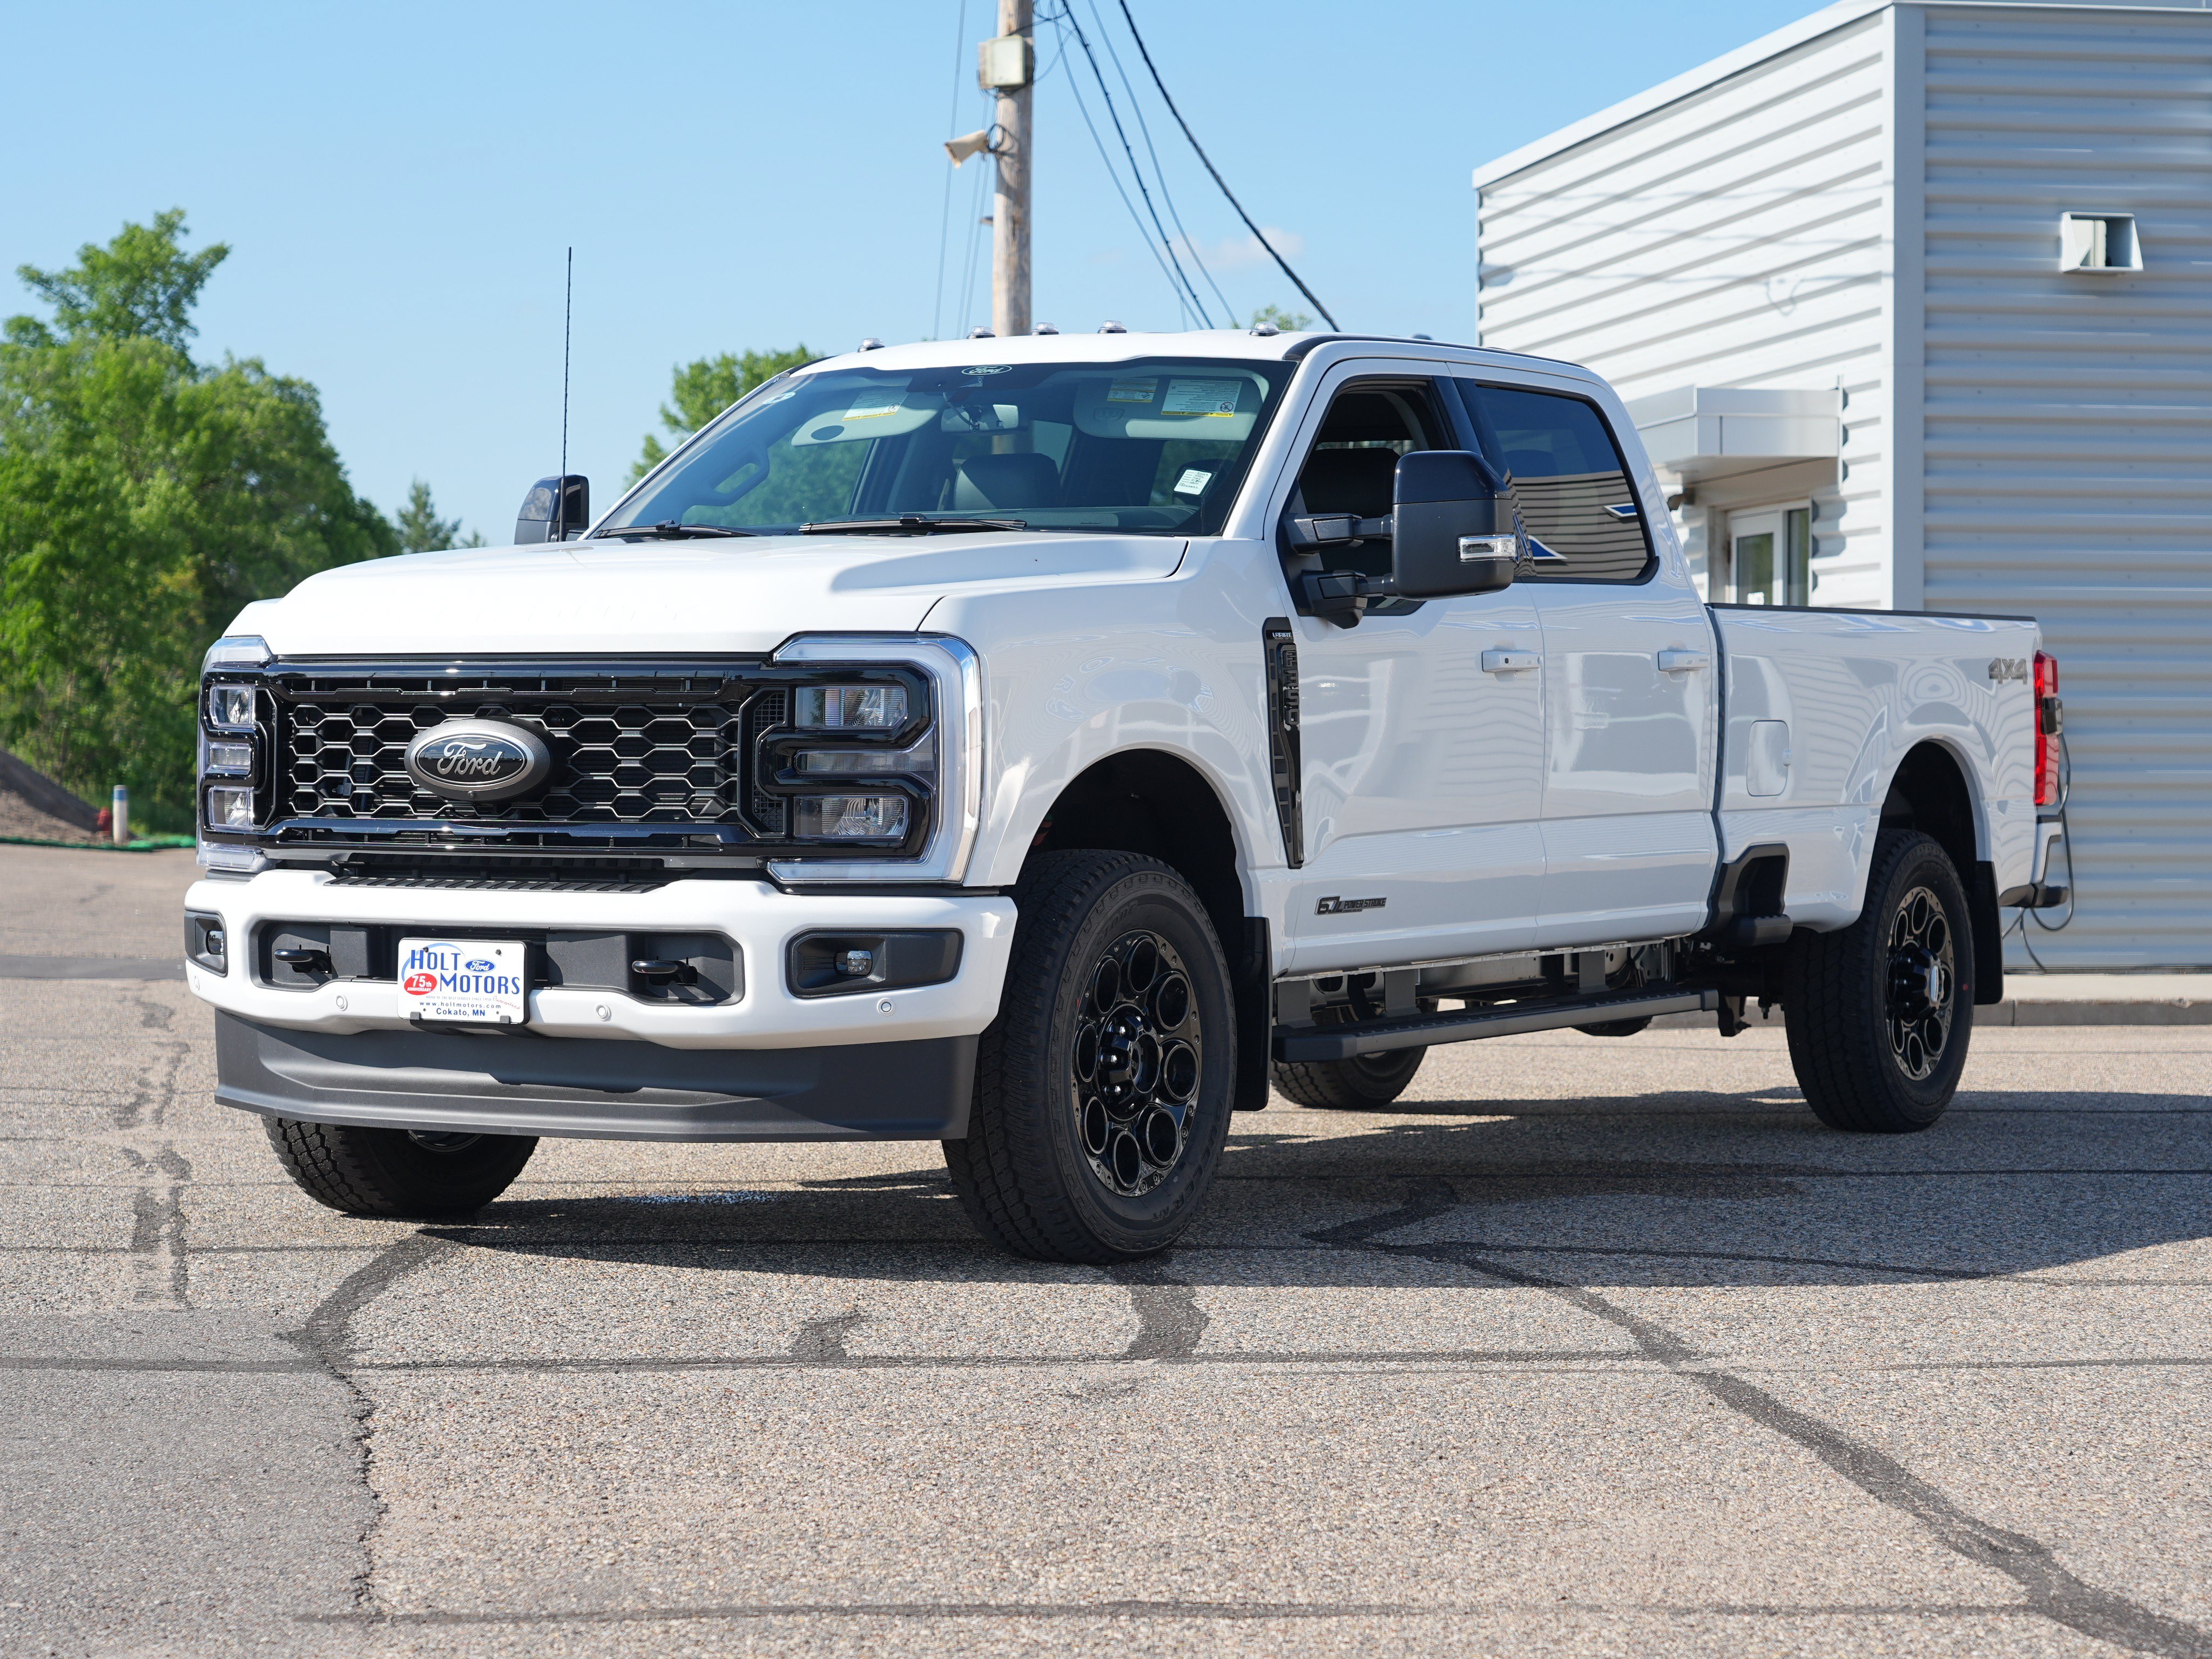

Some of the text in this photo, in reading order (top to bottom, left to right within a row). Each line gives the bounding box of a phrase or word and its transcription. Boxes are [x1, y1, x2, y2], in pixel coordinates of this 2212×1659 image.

[437, 741, 505, 775] Ford
[410, 949, 461, 970] HOLT
[470, 960, 490, 971] Ford
[412, 975, 432, 988] 75th
[440, 972, 520, 994] MOTORS
[436, 1008, 469, 1017] Cokato,
